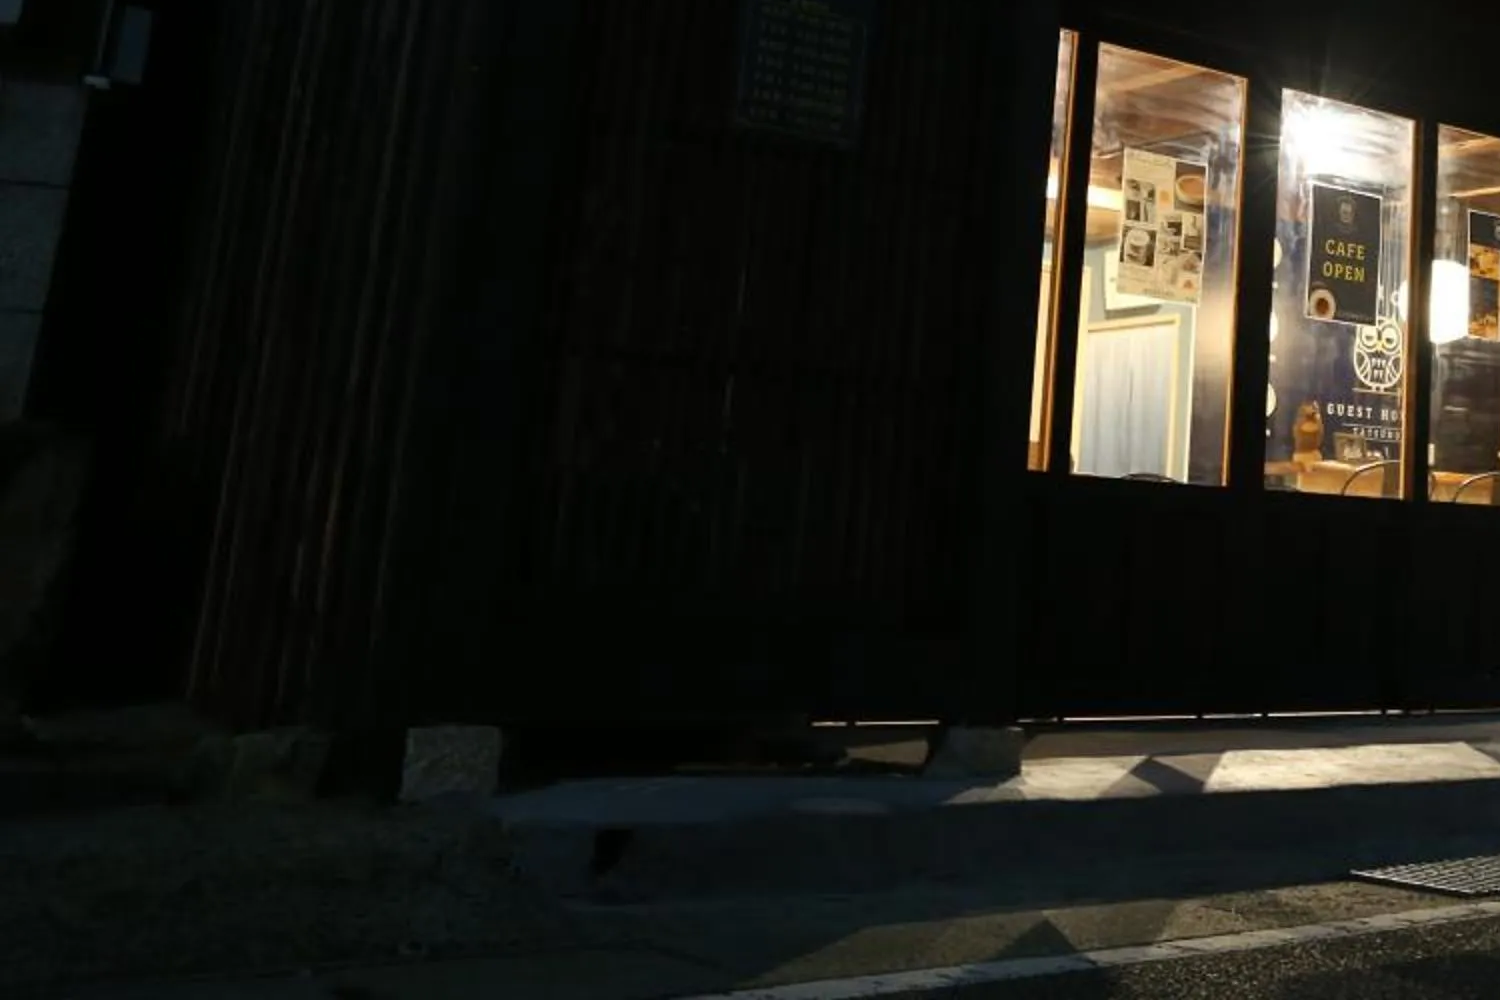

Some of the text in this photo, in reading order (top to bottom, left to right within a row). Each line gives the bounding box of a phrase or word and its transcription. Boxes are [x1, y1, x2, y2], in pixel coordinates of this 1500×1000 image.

[1325, 239, 1366, 260] CAFE
[1323, 261, 1365, 282] OPEN
[1327, 403, 1373, 419] GUEST
